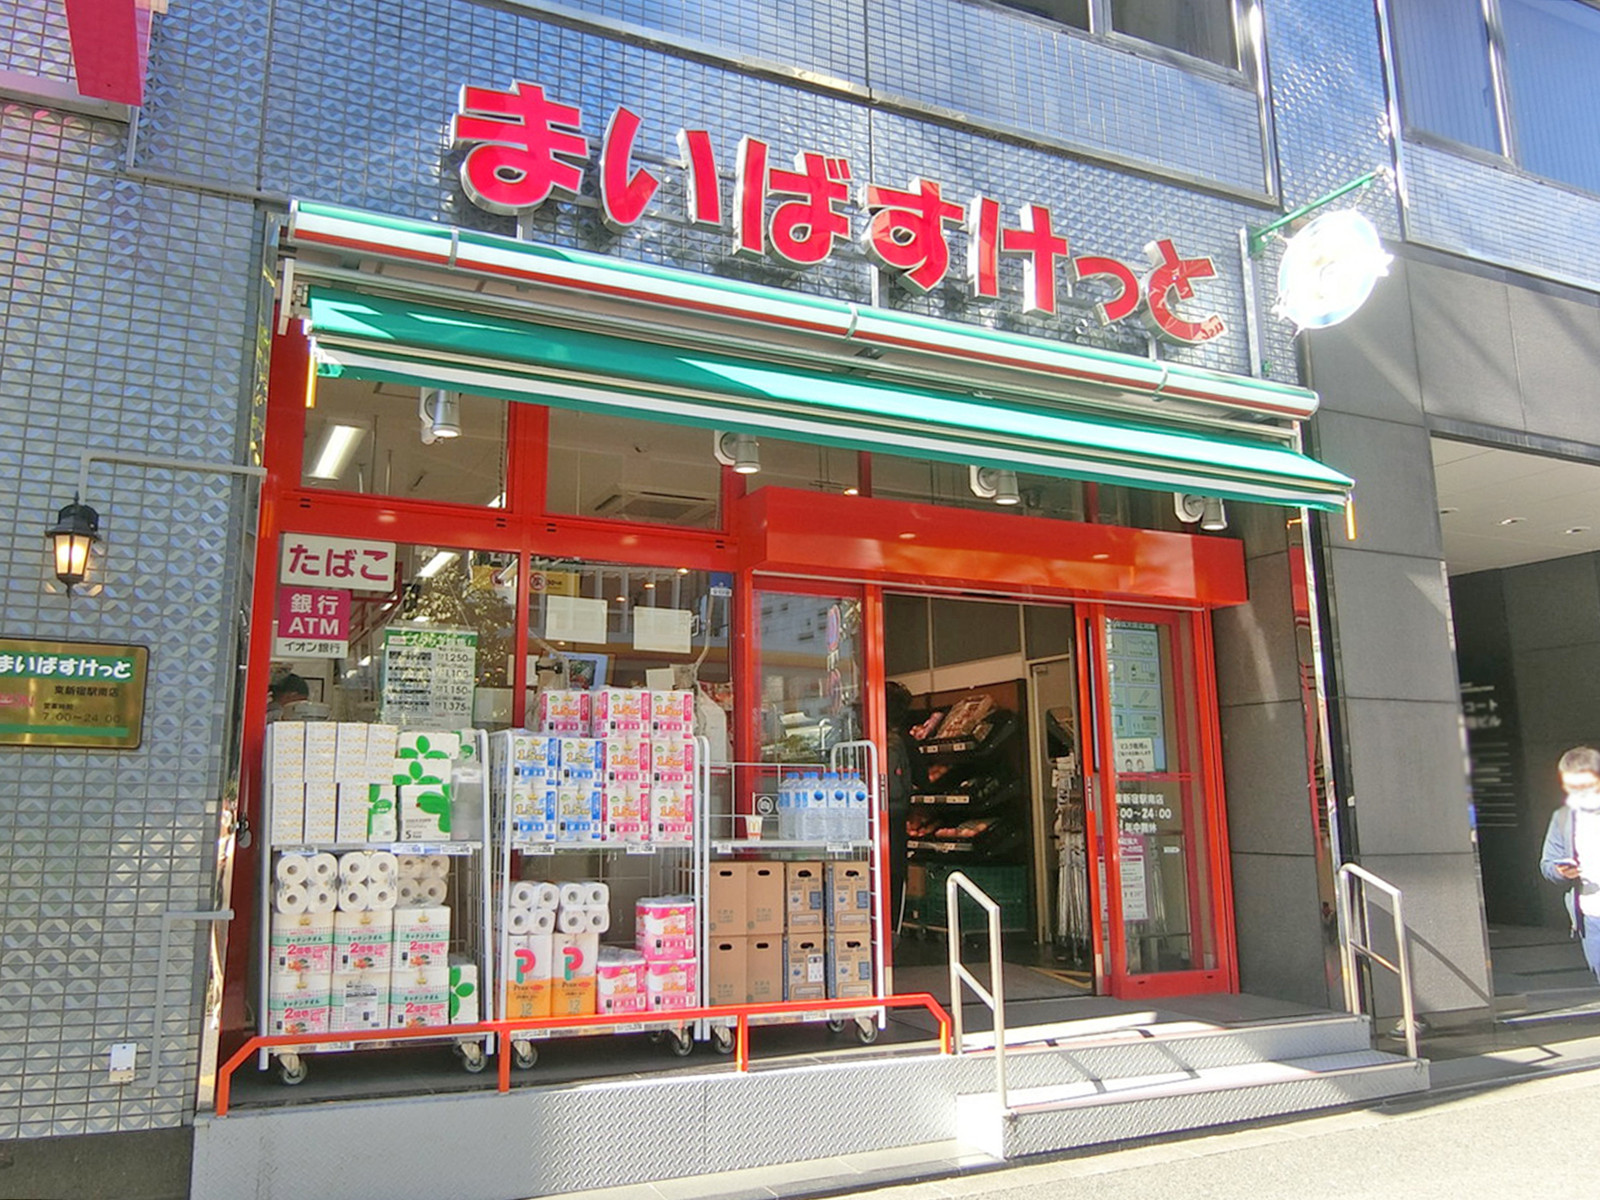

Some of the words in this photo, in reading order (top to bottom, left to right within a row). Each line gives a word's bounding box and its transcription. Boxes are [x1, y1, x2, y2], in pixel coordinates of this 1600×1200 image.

[450, 80, 1228, 346] まいばすけっと
[289, 544, 388, 581] たばこ
[290, 593, 339, 615] 銀行
[288, 617, 340, 636] ATM
[284, 641, 341, 654] イオン銀行
[0, 655, 131, 678] まいばすけっと
